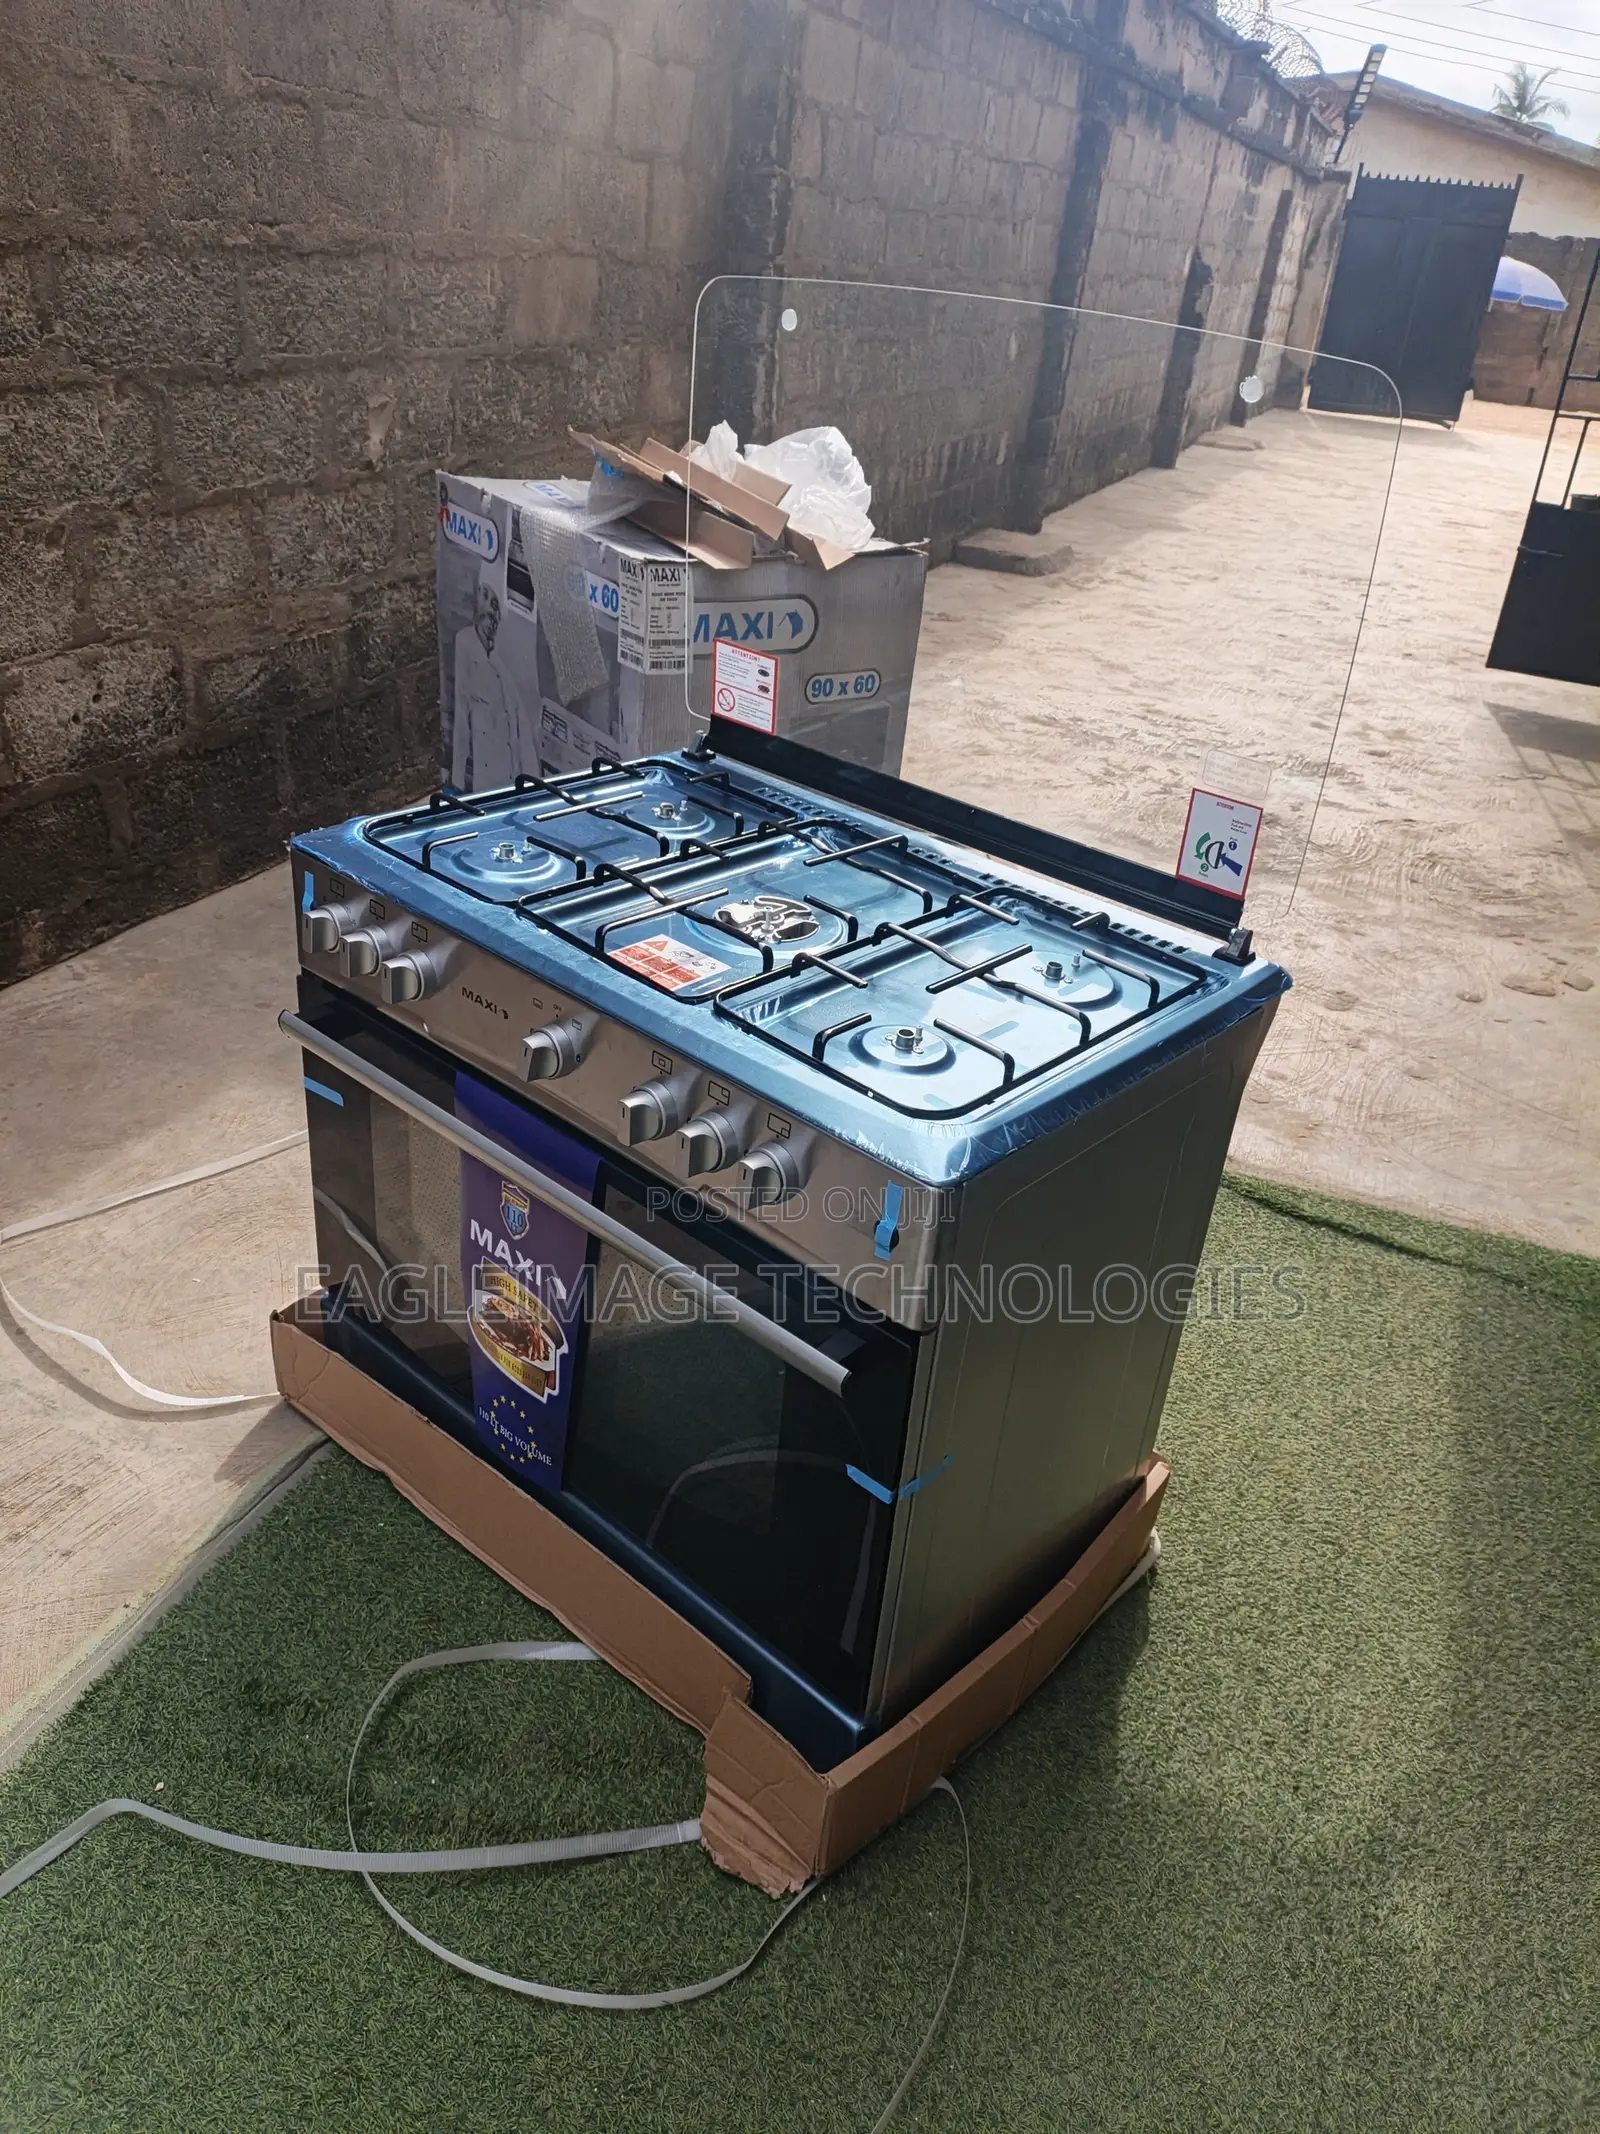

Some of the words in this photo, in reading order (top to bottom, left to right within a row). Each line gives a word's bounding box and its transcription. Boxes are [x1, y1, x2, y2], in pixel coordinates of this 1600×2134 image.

[446, 511, 482, 546] MAXI
[650, 567, 682, 583] MAXI
[589, 583, 598, 603] x
[601, 583, 620, 613] 60
[693, 611, 774, 643] MAXI
[811, 678, 834, 698] 90
[837, 681, 849, 696] x
[853, 673, 876, 694] 60
[462, 986, 497, 1014] MAXI
[506, 1205, 524, 1228] 110
[470, 1218, 542, 1287] MAXI
[490, 1274, 512, 1292] HIGH
[500, 1424, 514, 1442] BIG
[515, 1435, 553, 1466] VOLUME
